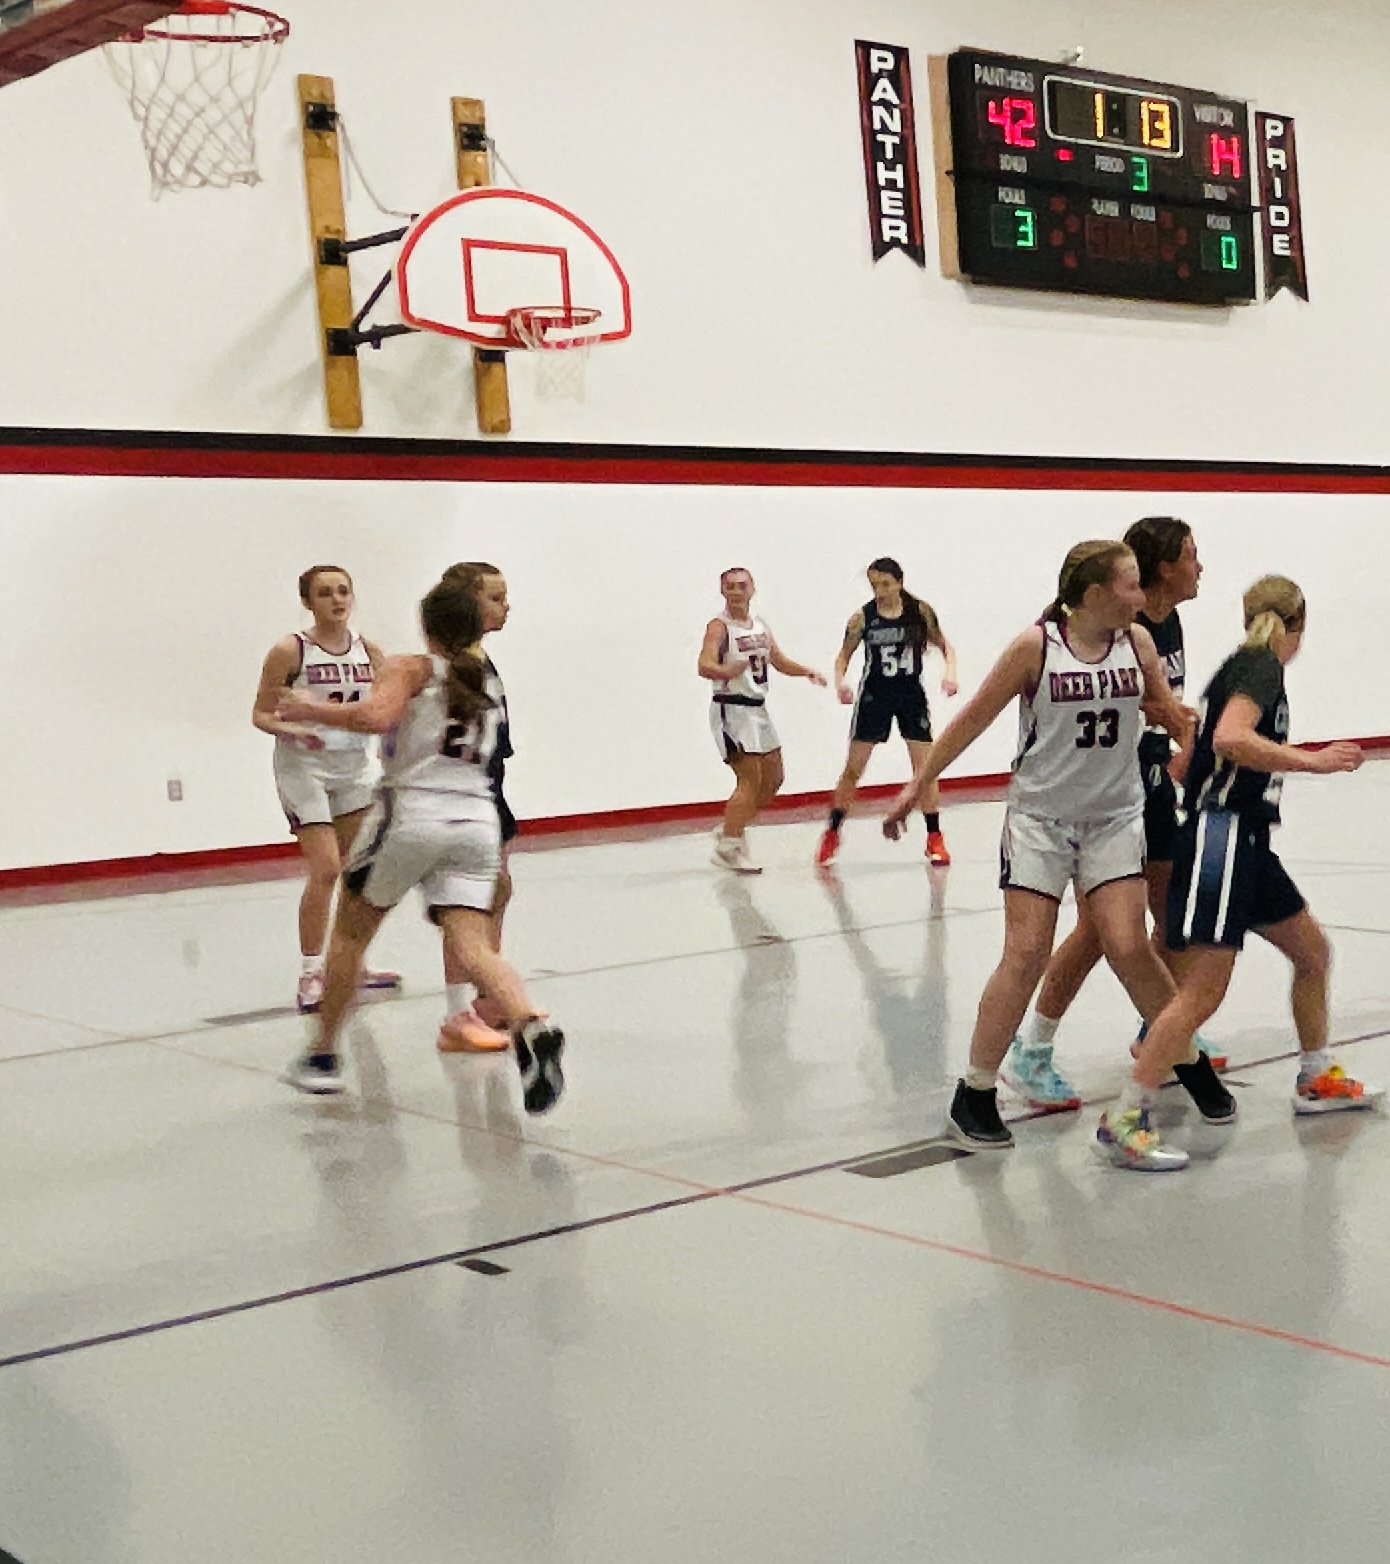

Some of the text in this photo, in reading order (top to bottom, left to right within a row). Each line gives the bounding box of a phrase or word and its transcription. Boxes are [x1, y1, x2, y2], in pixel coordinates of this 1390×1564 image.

[974, 63, 1034, 93] PANTHERS
[988, 97, 1036, 147] 42
[870, 48, 908, 244] PANTHER
[1210, 133, 1241, 178] 14
[1131, 156, 1148, 192] 3
[1265, 118, 1291, 256] PRIDE
[1014, 209, 1033, 247] 3
[1220, 235, 1237, 270] 0
[880, 644, 914, 677] 54
[1049, 667, 1140, 703] DEER PARK
[1075, 708, 1120, 748] 33
